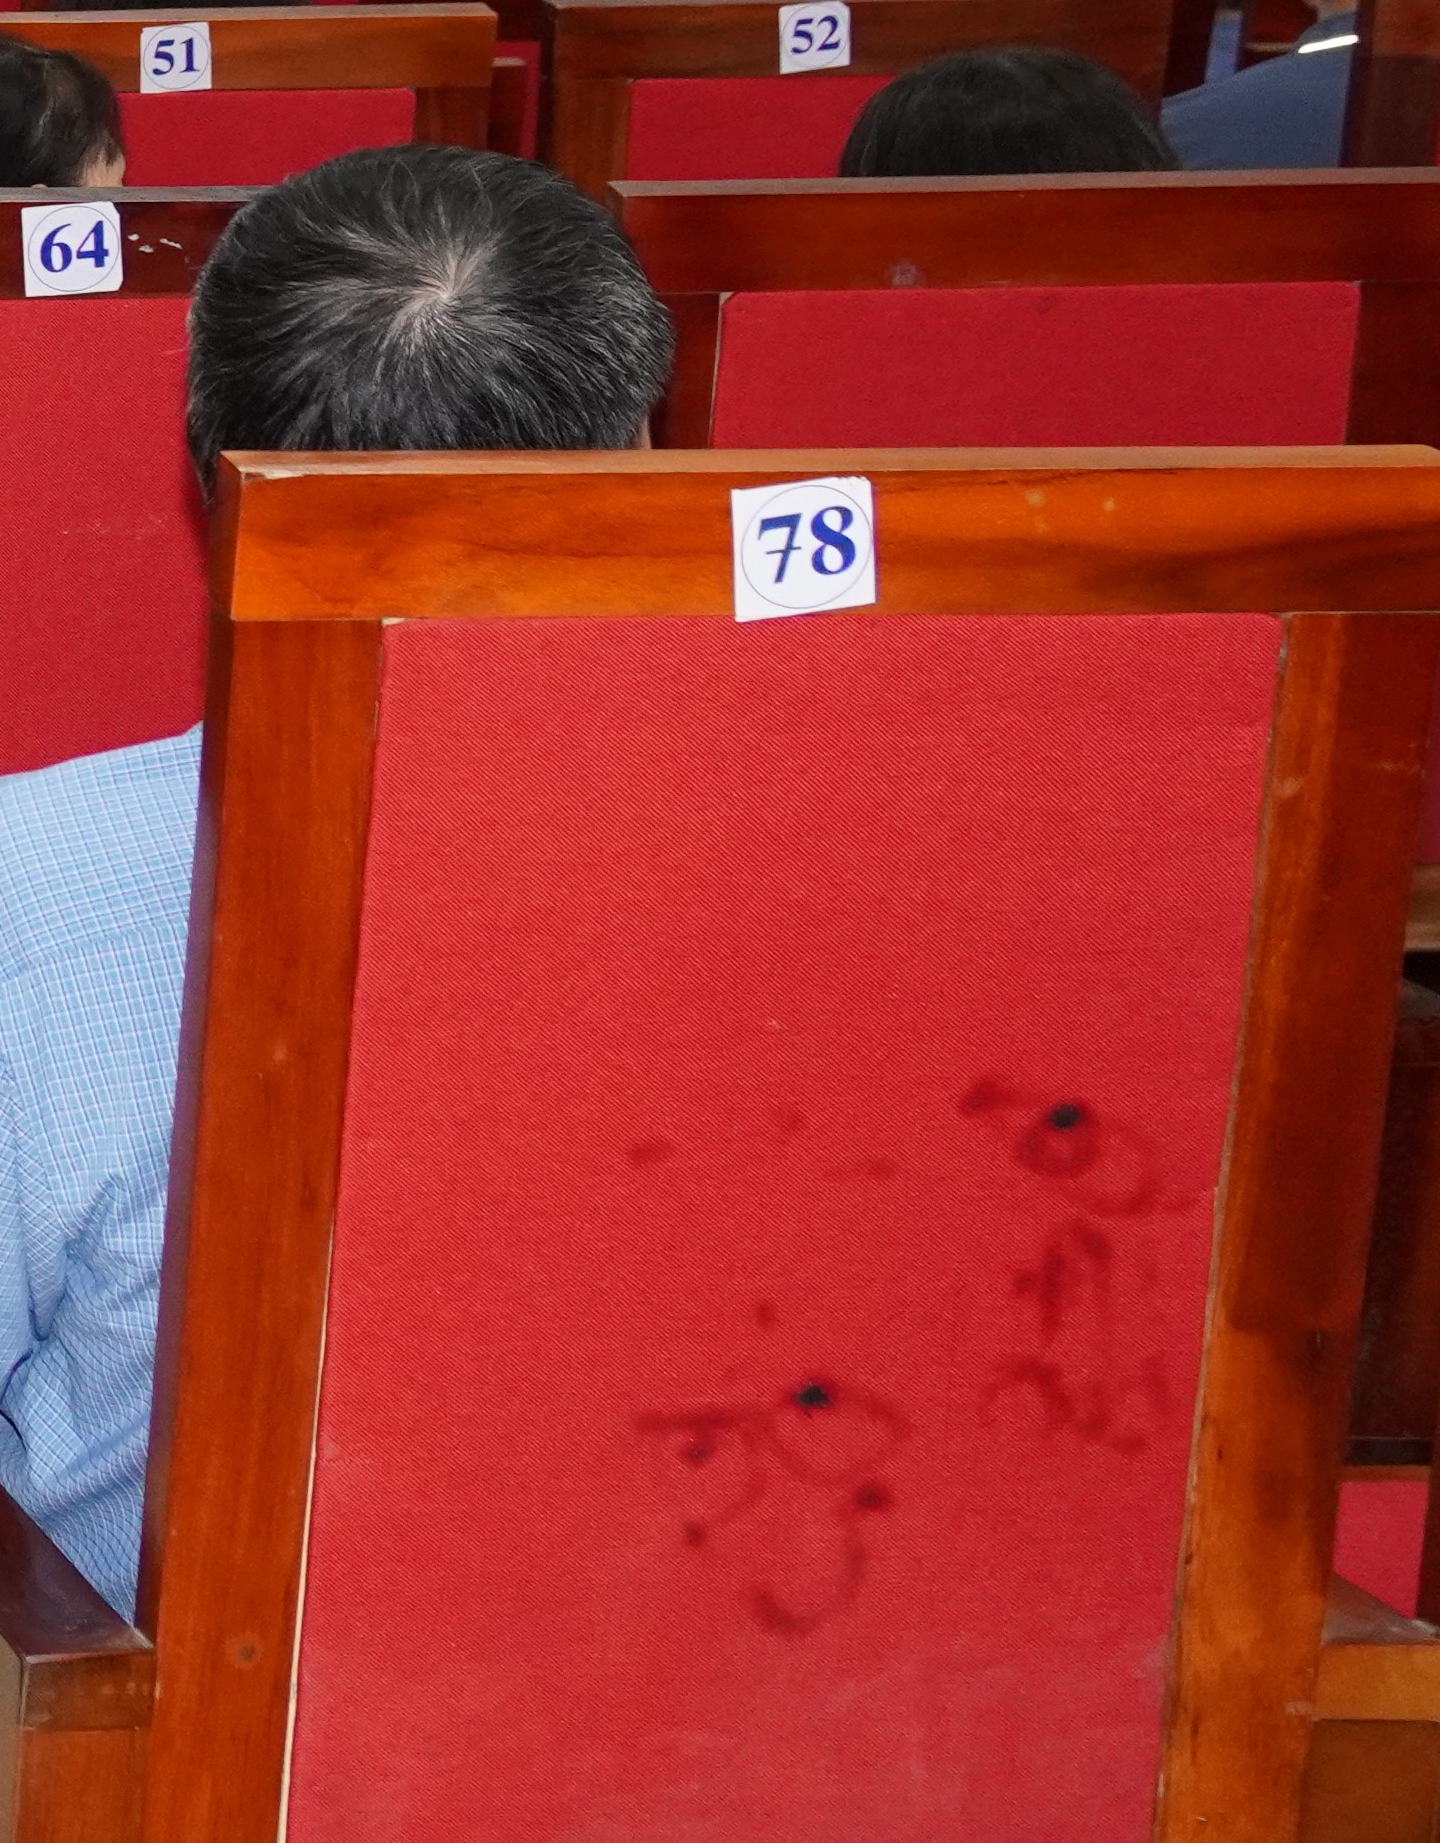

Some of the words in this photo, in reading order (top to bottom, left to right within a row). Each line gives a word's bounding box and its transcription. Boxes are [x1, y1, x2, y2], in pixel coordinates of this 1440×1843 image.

[152, 37, 200, 76] 51
[790, 15, 841, 55] 52
[40, 220, 110, 273] 64
[758, 505, 856, 584] 78
